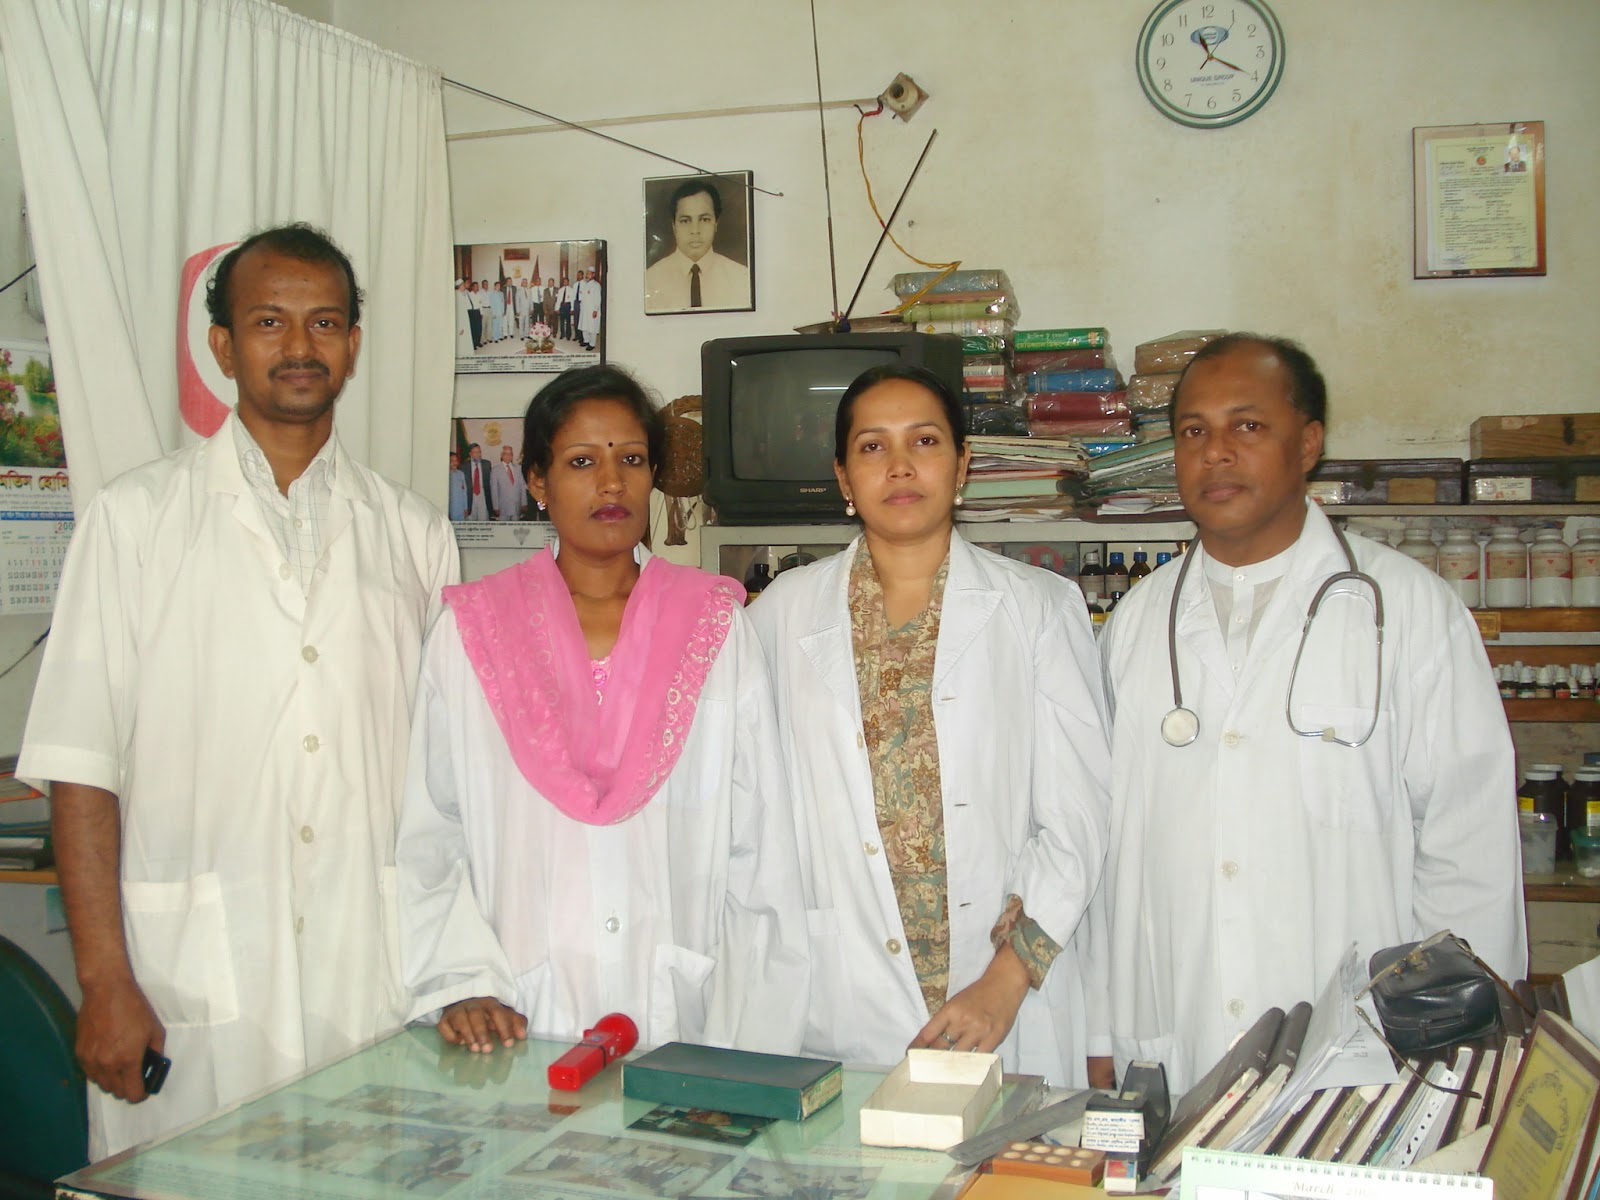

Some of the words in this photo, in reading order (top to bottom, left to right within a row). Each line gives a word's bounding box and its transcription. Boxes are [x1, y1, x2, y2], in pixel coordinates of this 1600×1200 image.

[1202, 4, 1214, 19] 12
[1231, 9, 1235, 22] 1
[1178, 14, 1188, 27] 11
[1247, 24, 1257, 38] 2
[1161, 33, 1174, 47] 10
[1256, 45, 1265, 59] 3
[1156, 58, 1166, 70] 9
[1250, 70, 1259, 82] 4
[1163, 79, 1173, 92] 8
[1185, 93, 1192, 107] 7
[1232, 89, 1241, 102] 5
[1207, 96, 1217, 109] 6
[57, 521, 76, 531] 200
[1292, 1181, 1335, 1194] March
